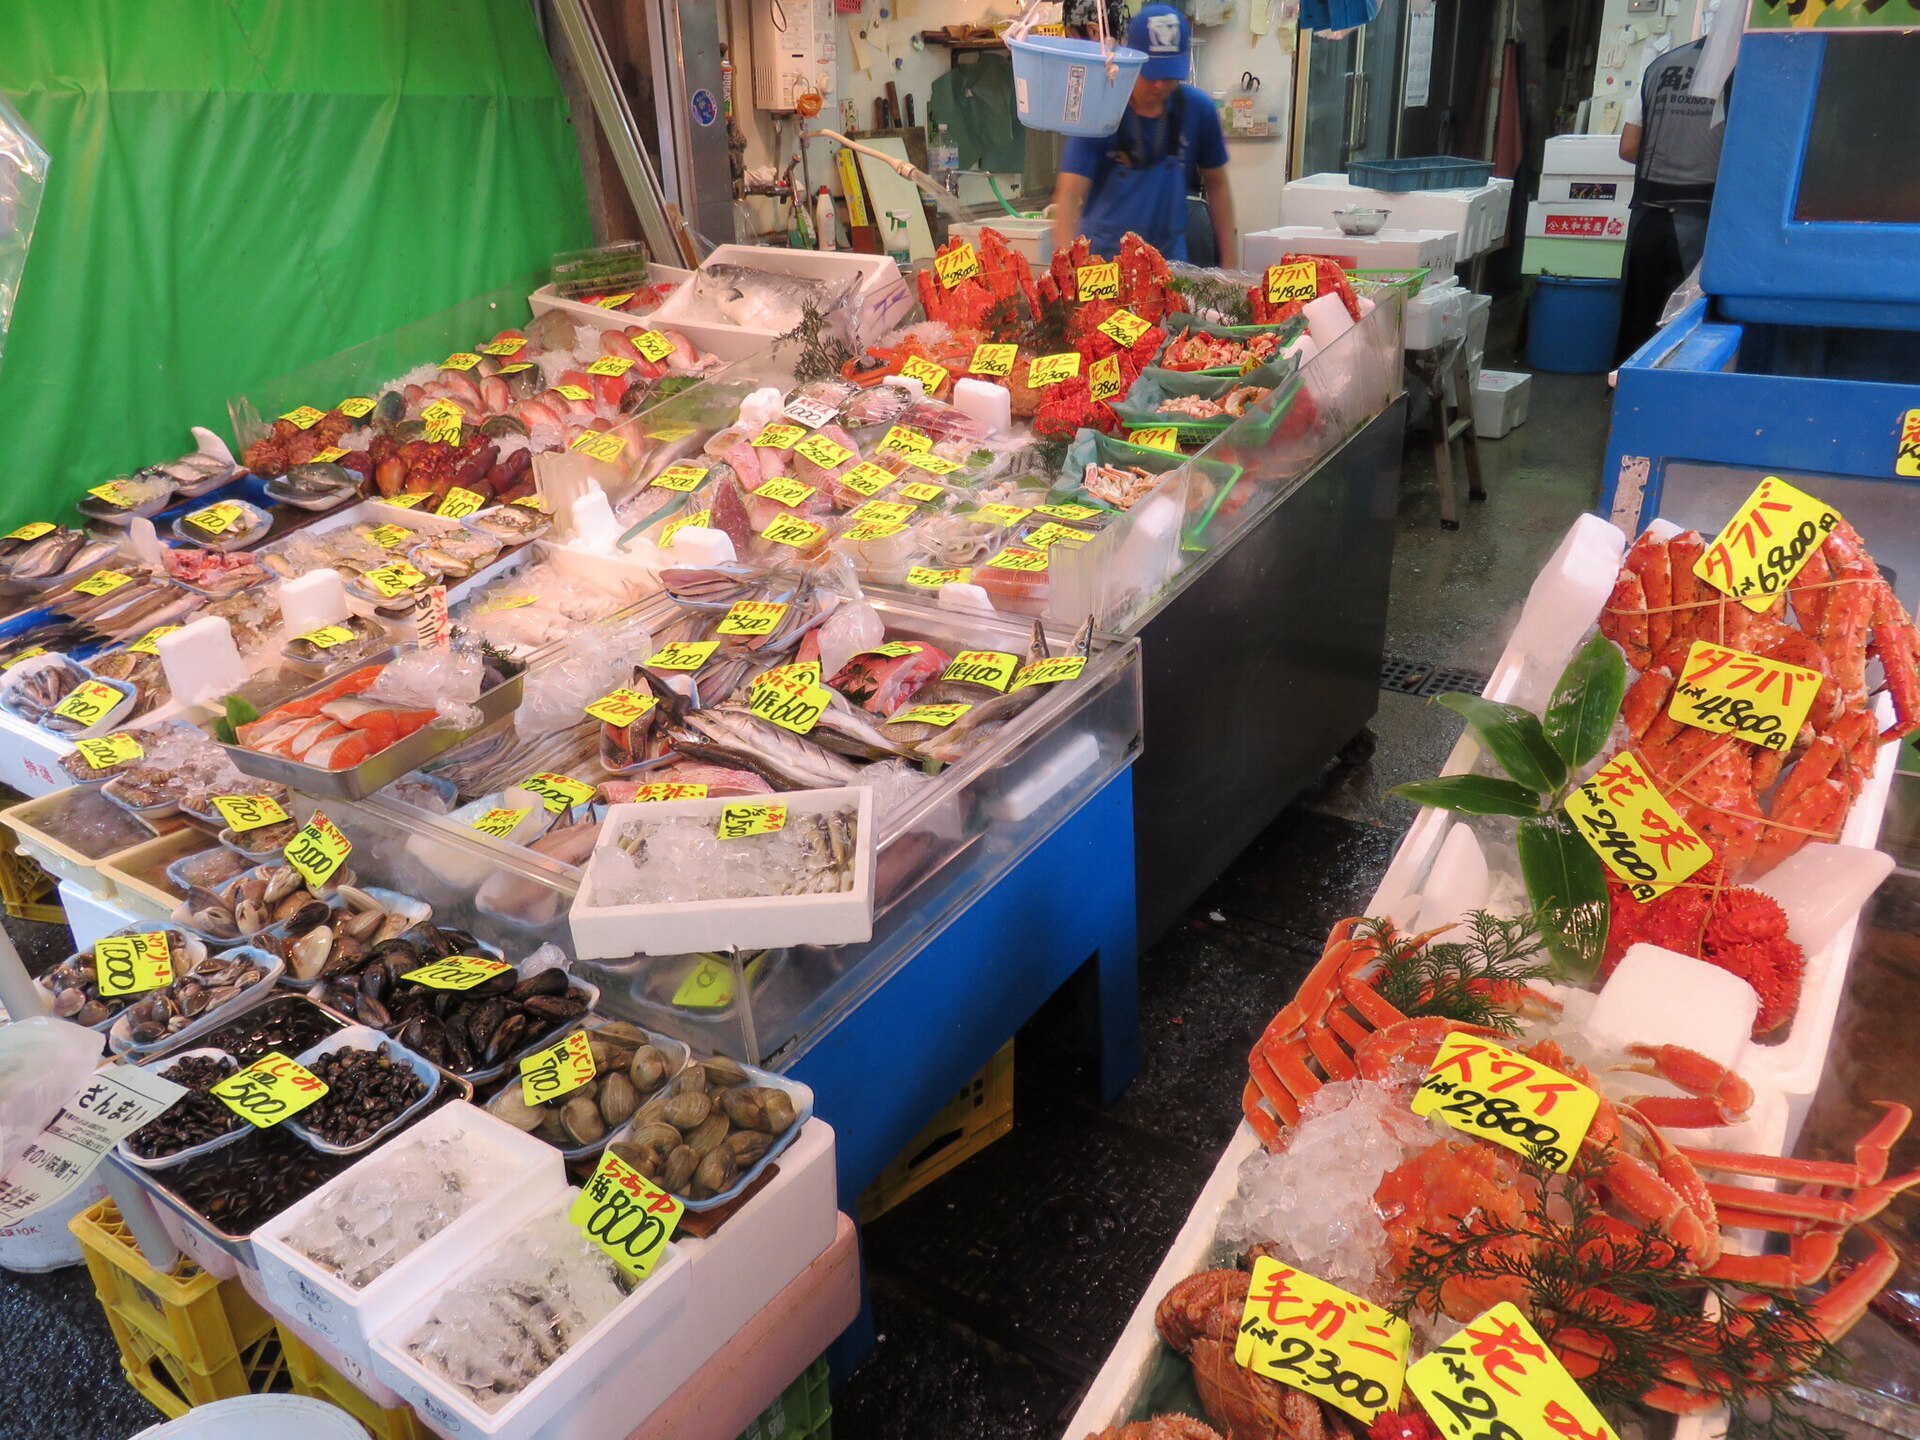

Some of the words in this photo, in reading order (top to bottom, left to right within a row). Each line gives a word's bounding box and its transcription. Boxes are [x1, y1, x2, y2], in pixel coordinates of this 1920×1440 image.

[1080, 266, 1118, 284] タラバ
[1270, 263, 1313, 283] タラバ
[1131, 428, 1173, 446] ズワイ
[1703, 481, 1793, 590] タラバ
[1686, 648, 1817, 707] タラバ
[1597, 761, 1701, 873] 花咲
[248, 1056, 323, 1092] しじみ
[1428, 1044, 1578, 1118] ズワイ
[1249, 1268, 1398, 1362] 毛ガニ
